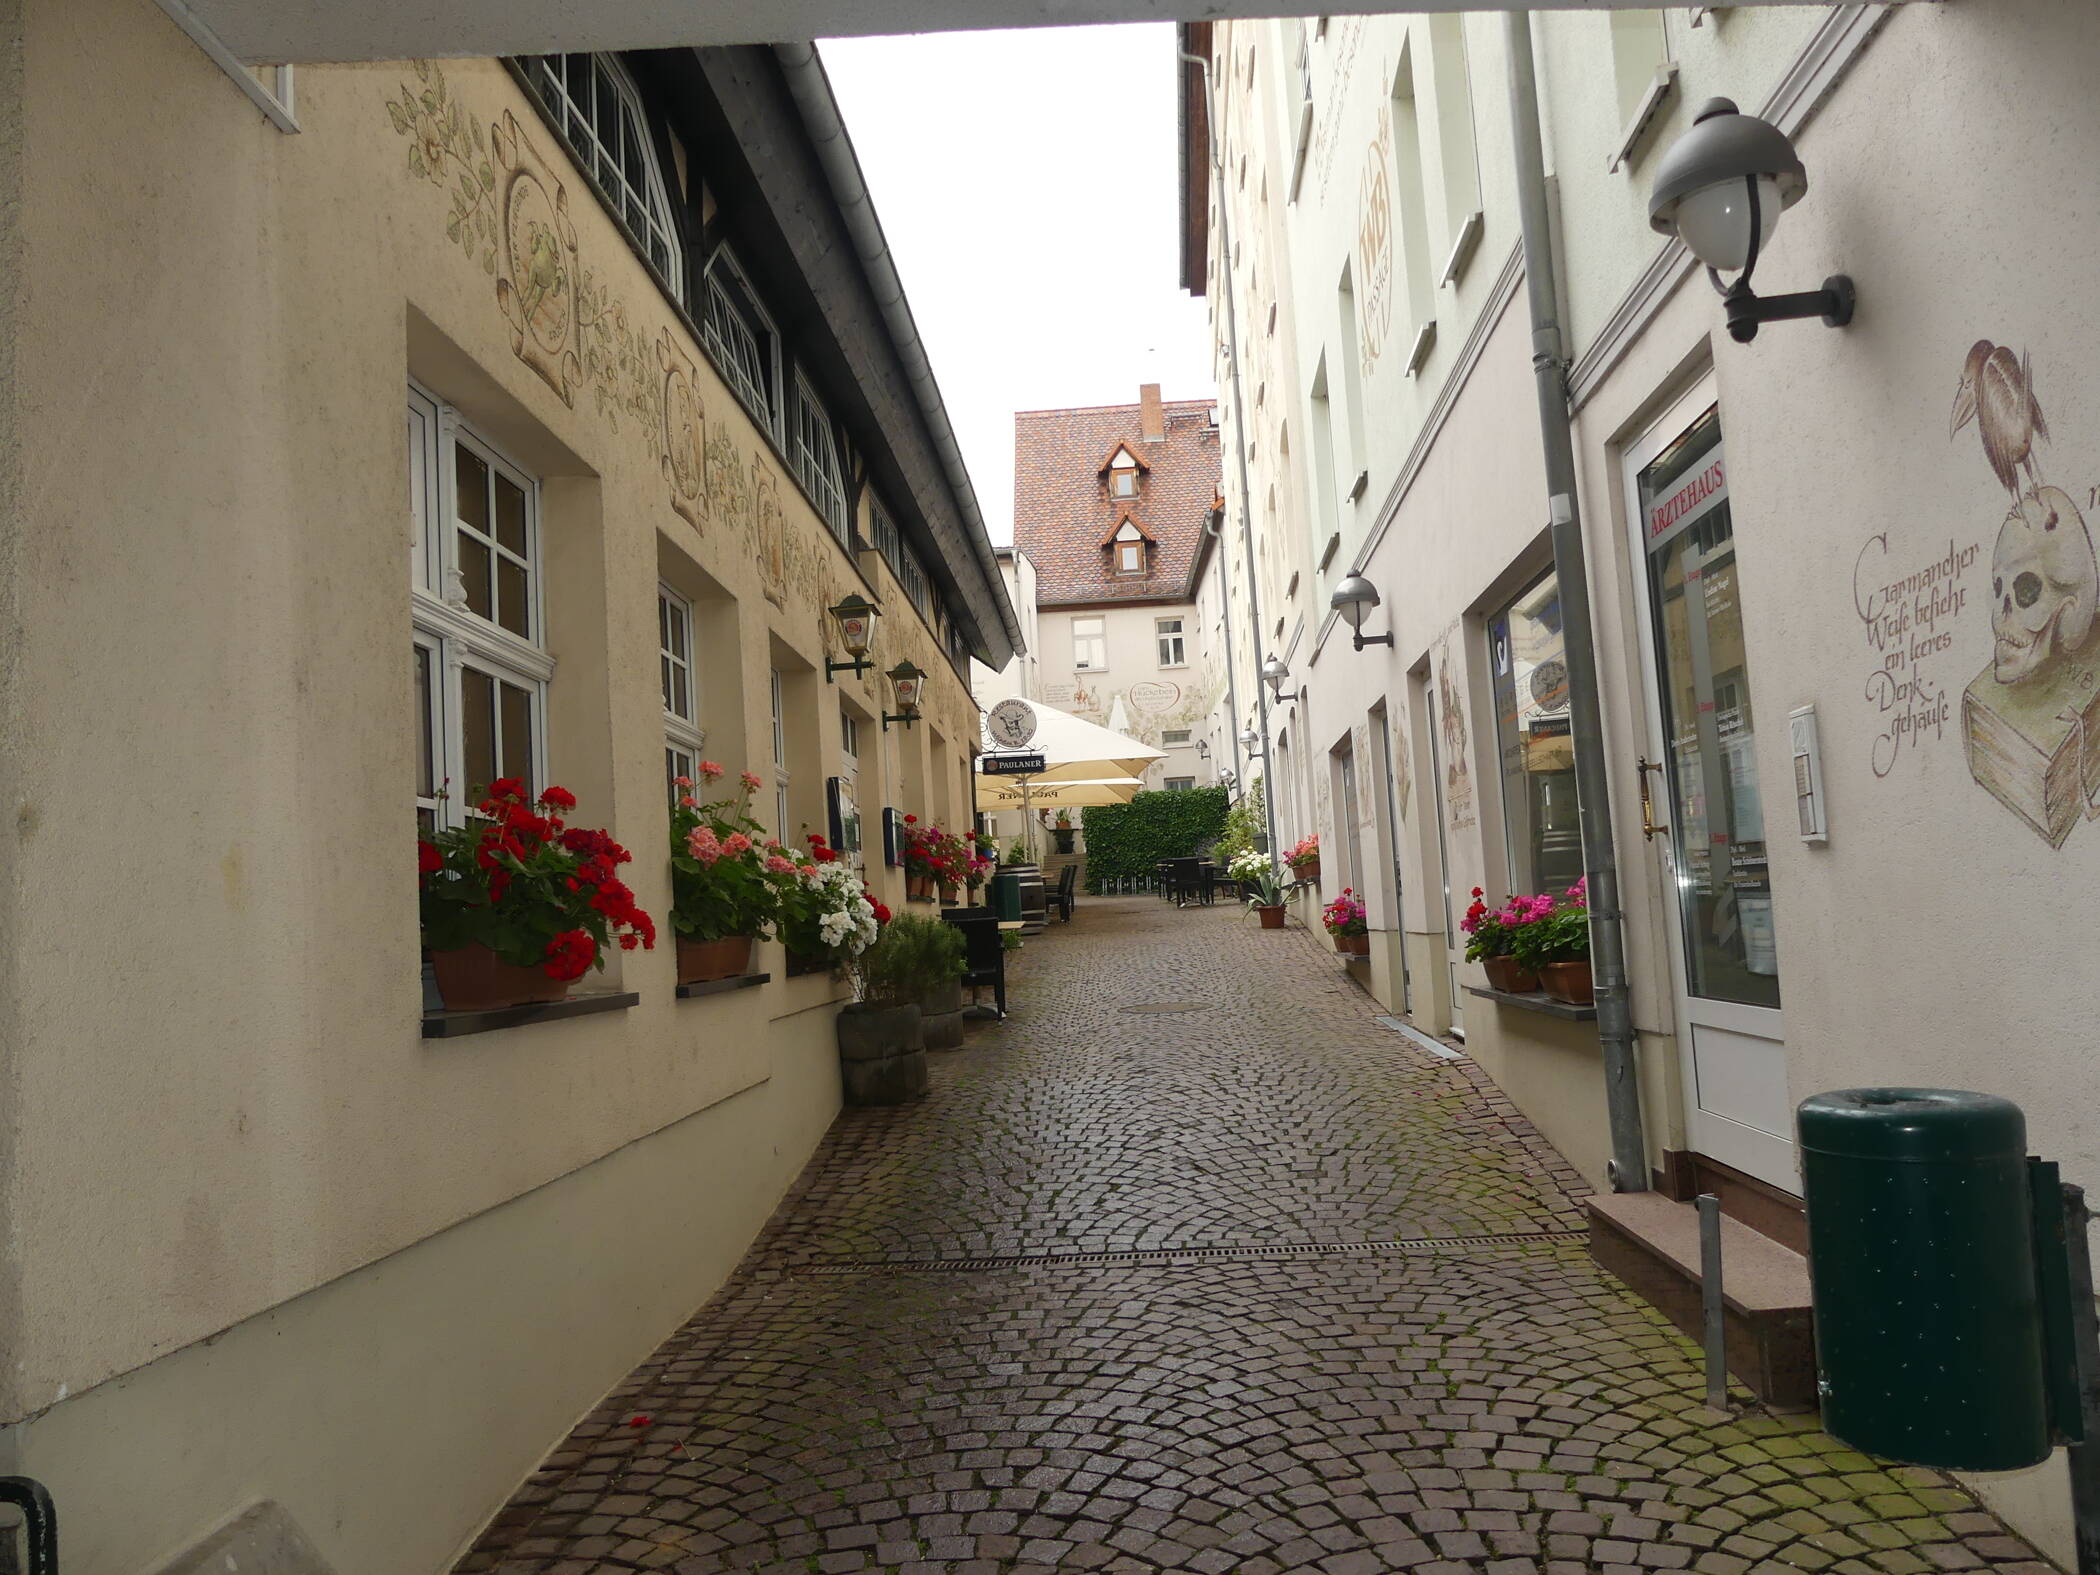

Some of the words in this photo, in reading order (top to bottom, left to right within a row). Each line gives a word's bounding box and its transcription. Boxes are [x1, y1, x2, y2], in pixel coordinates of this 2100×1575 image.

[1650, 459, 1724, 538] ÄRZTEHAUS
[1884, 643, 1905, 671] ein
[1909, 631, 1952, 662] leeres
[999, 760, 1042, 769] PAULANER
